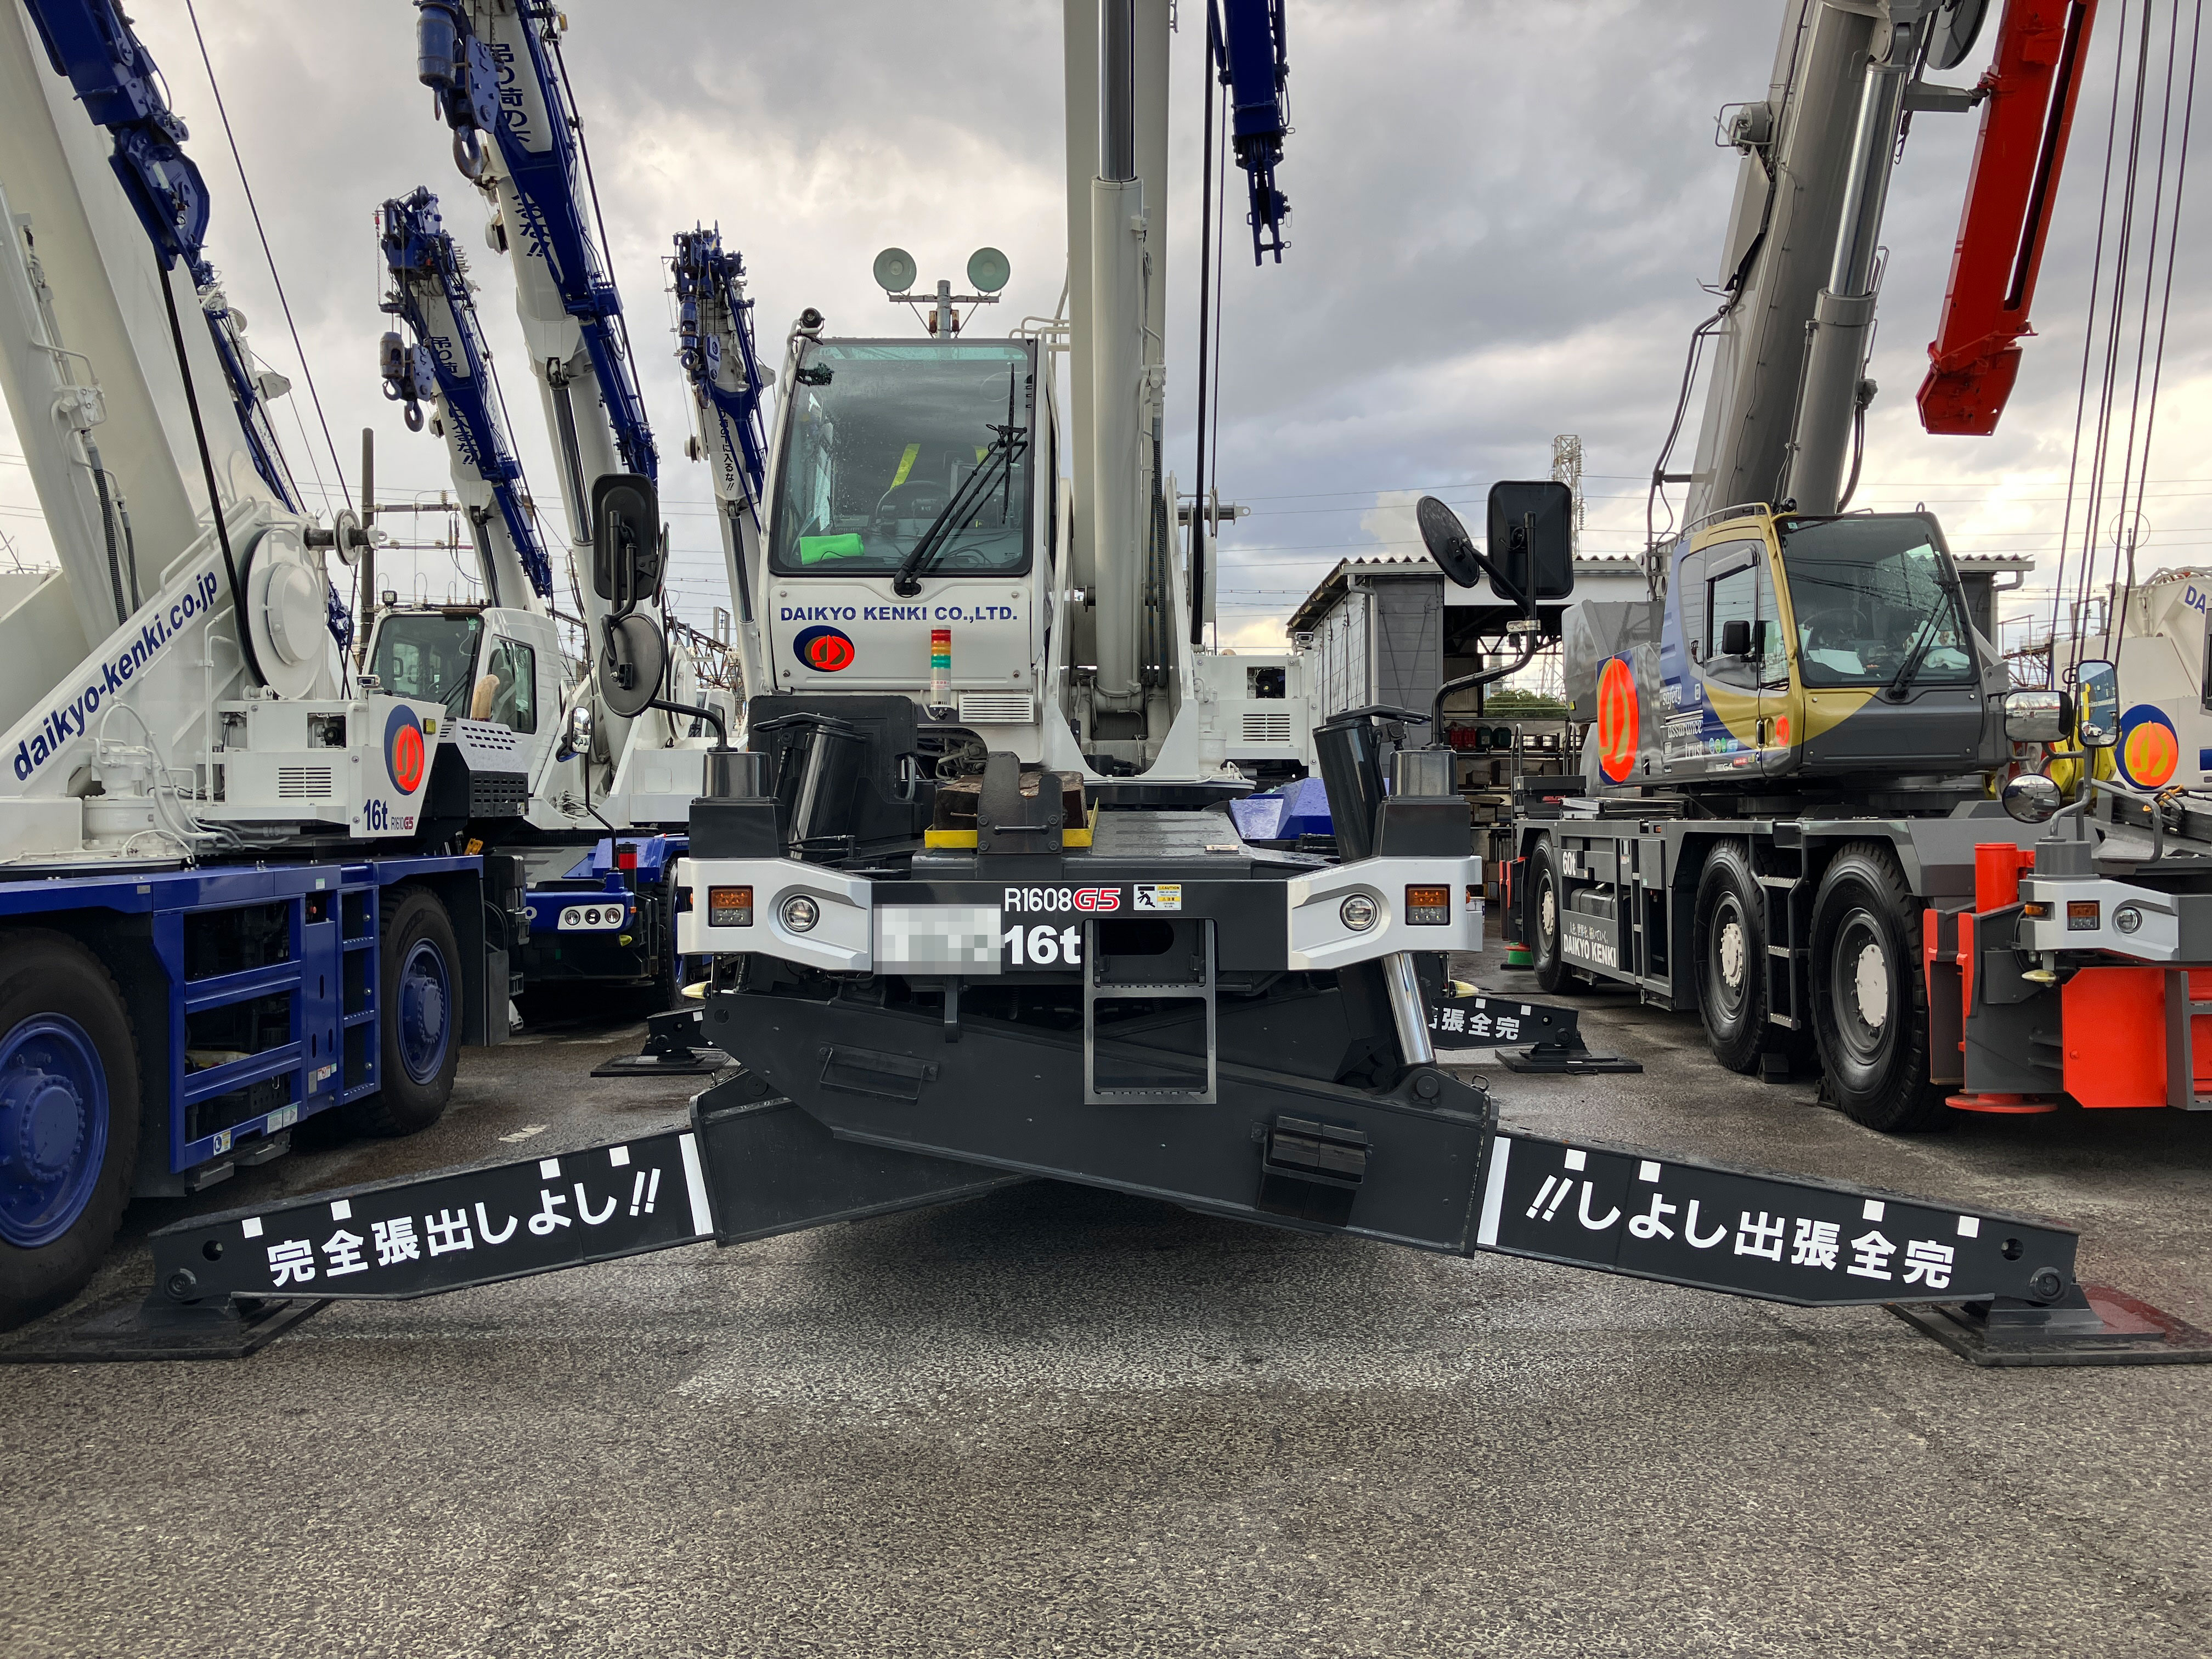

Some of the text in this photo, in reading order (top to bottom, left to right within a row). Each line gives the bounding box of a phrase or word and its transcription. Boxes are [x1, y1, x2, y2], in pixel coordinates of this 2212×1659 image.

[781, 606, 1017, 623] DAIKYO KENKI CO.,LTD.
[14, 571, 217, 781] daikyo-kenki.co.jp
[1662, 685, 1682, 710] safety
[1667, 719, 1703, 738] assurance
[1685, 741, 1703, 759] trust
[364, 799, 388, 831] 16t
[1562, 851, 1576, 876] 60t
[1005, 888, 1121, 912] R1608G5
[1005, 925, 1081, 964] 16t
[1564, 933, 1617, 968] DAIKYO KENKI
